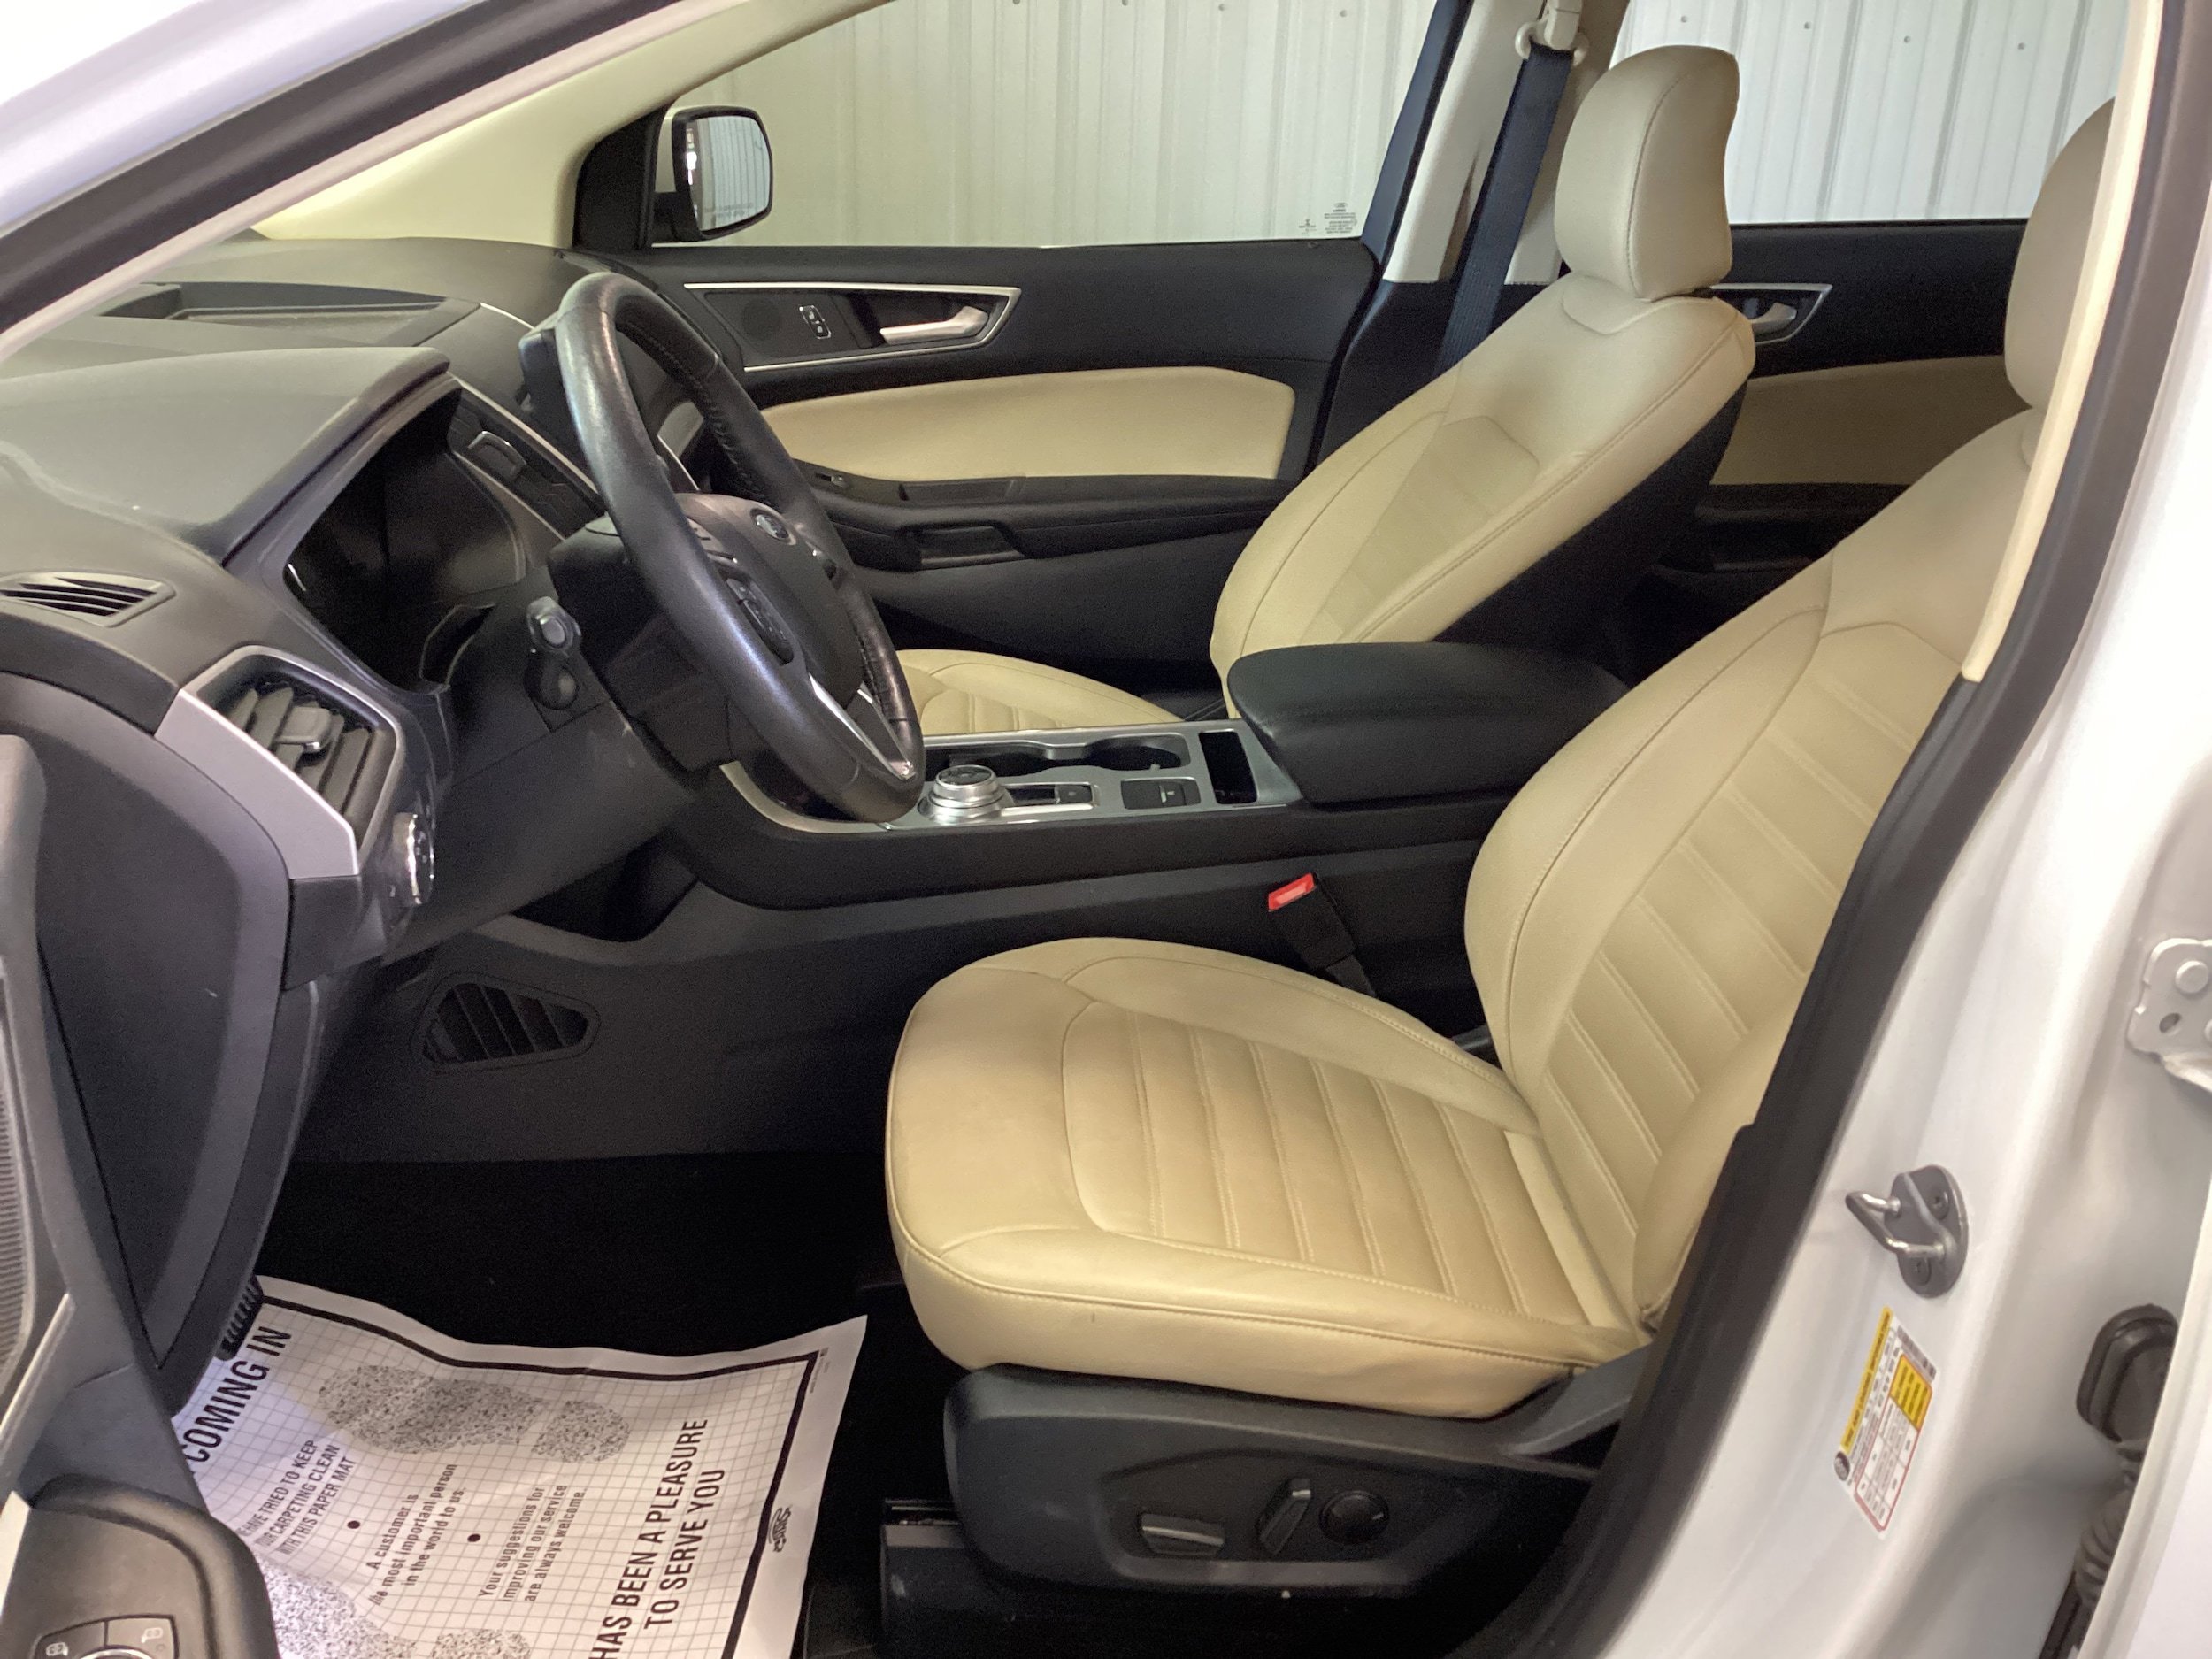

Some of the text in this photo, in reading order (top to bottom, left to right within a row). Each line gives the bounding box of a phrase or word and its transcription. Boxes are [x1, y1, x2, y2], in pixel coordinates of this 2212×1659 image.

[182, 1325, 292, 1463] COMING IN
[243, 1514, 269, 1535] HAVE
[258, 1486, 289, 1514] TRIED
[280, 1471, 300, 1485] TO
[292, 1440, 318, 1469] KEEP
[269, 1483, 317, 1535] CARPETING
[309, 1444, 341, 1482] CLEAN
[291, 1517, 318, 1540] THIS
[309, 1483, 342, 1517] PAPER
[332, 1456, 356, 1481] MAT
[365, 1494, 419, 1571] A customer is
[368, 1464, 457, 1606] the most important person
[478, 1487, 545, 1598] Your suggestions for
[502, 1485, 568, 1602] improving our service
[588, 1419, 708, 1659] HAS BEEN A PLEASURE
[401, 1573, 419, 1586] in
[411, 1554, 430, 1574] the
[424, 1519, 449, 1551] world
[441, 1506, 457, 1518] to
[524, 1488, 587, 1601] are always welcome.
[643, 1469, 726, 1630] TO SERVE YOU
